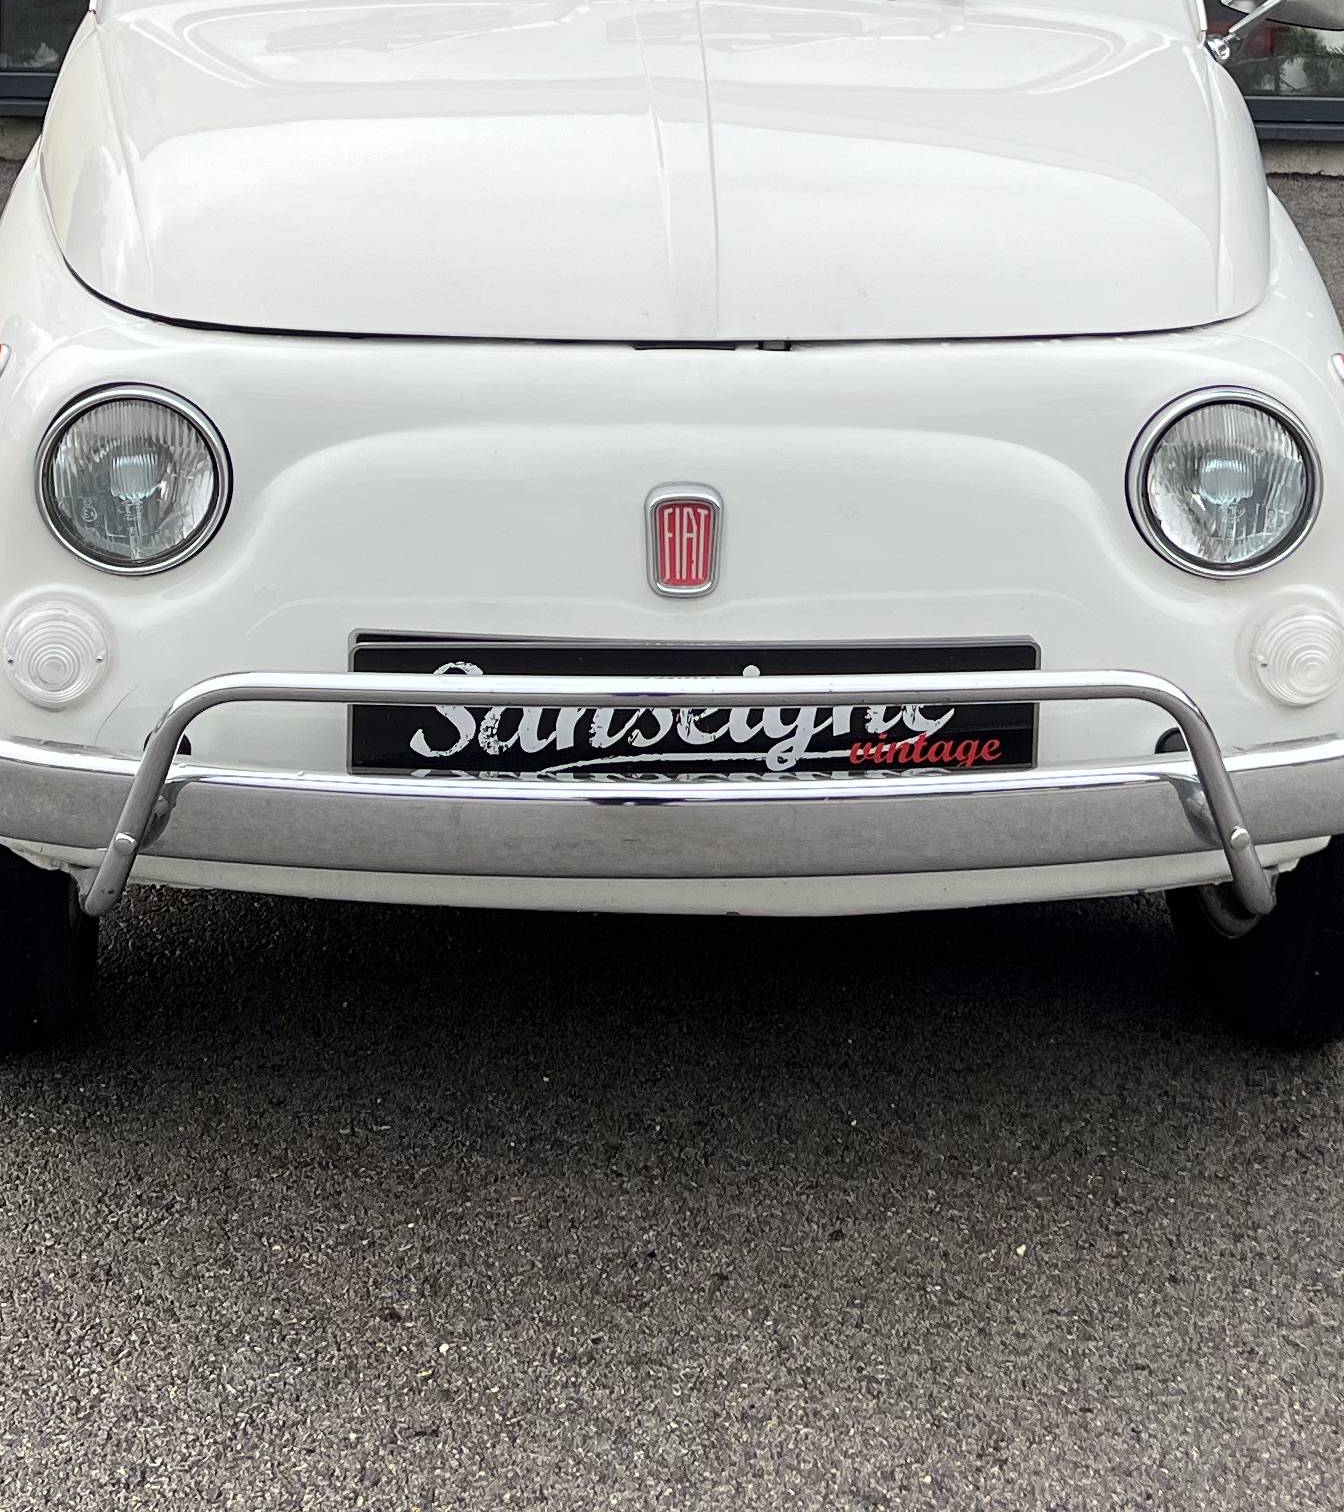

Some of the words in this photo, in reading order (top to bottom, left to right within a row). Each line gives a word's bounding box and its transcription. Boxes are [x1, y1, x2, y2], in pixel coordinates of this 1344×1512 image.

[663, 507, 709, 580] FIAT
[409, 661, 956, 771] Sanseigne
[849, 732, 1003, 768] vintage
